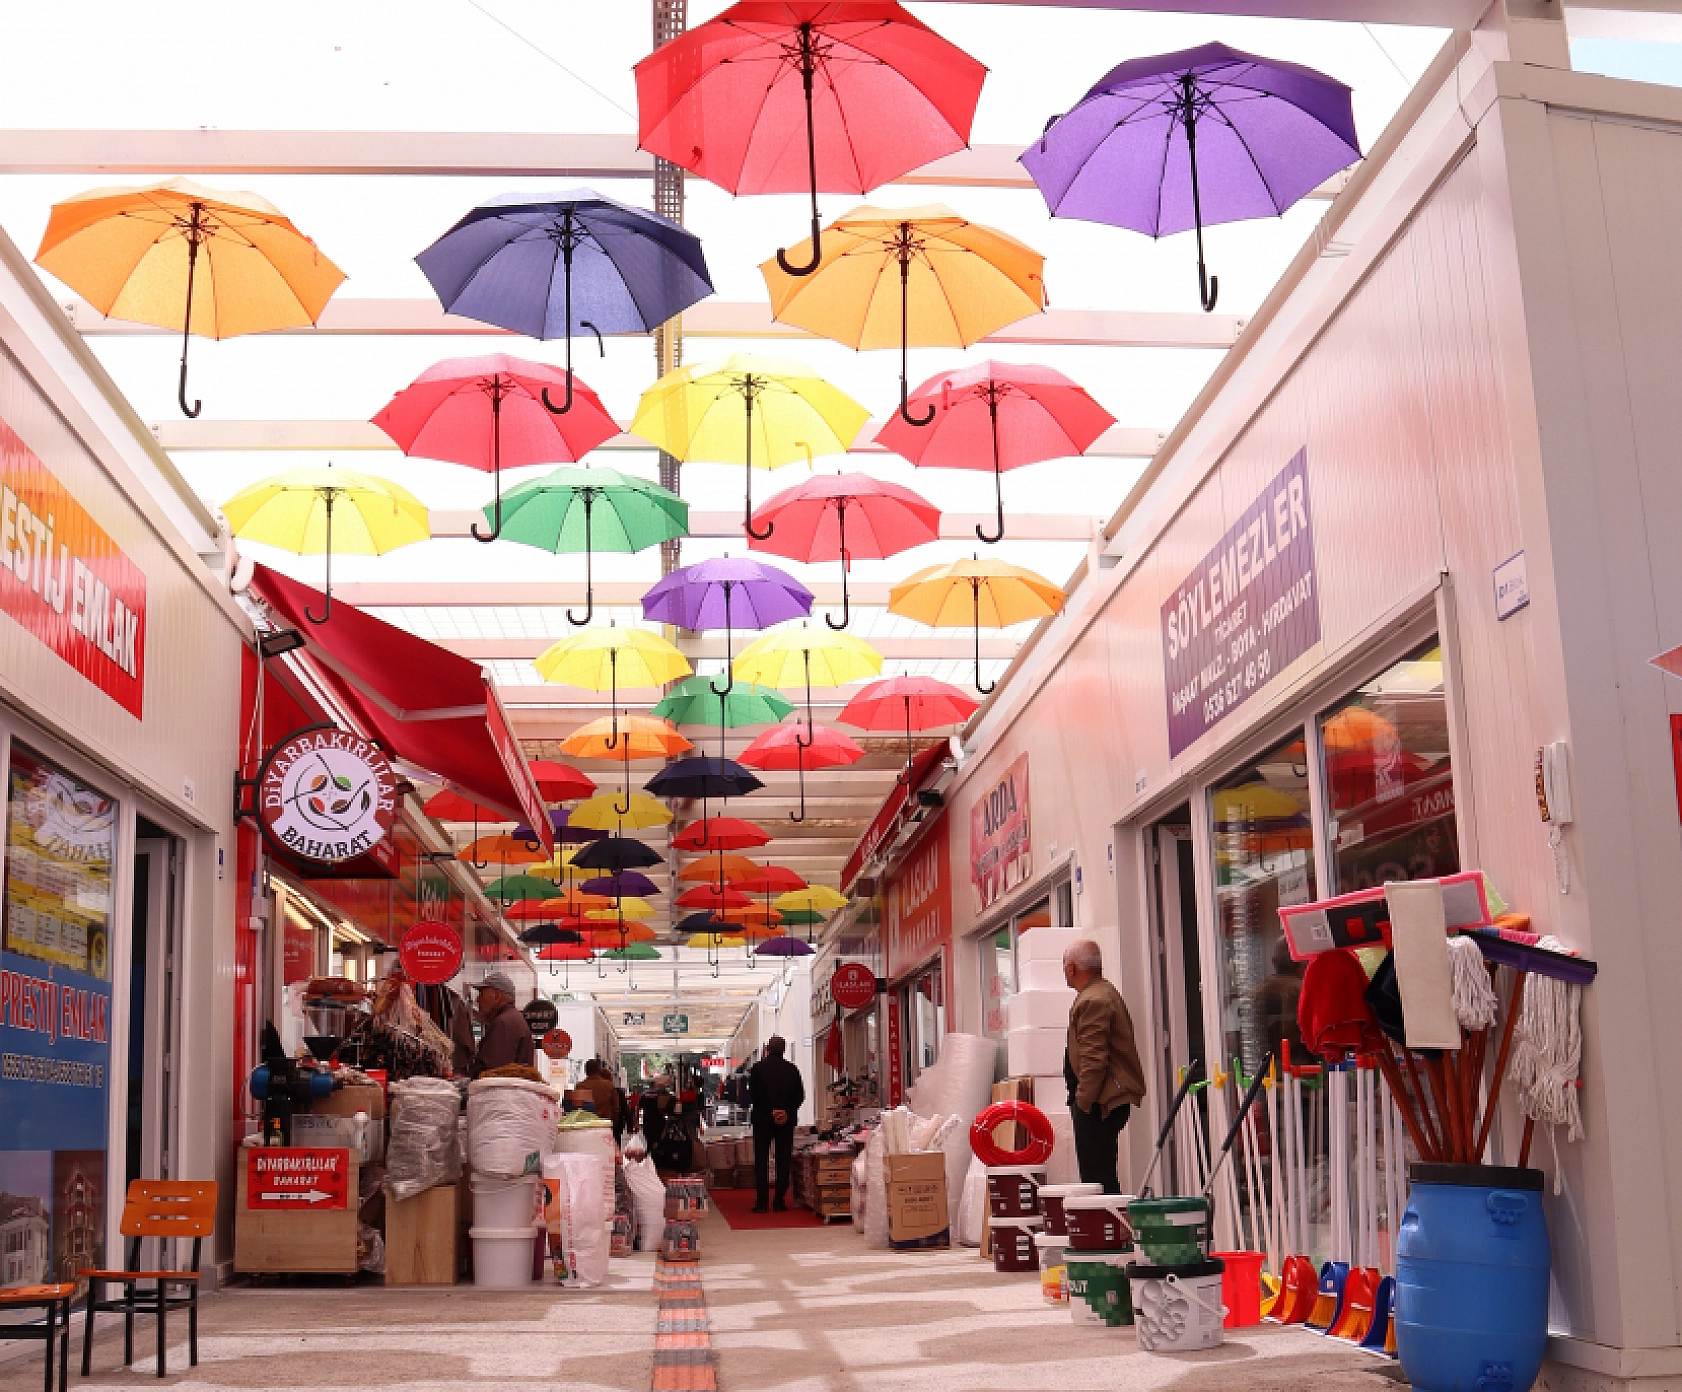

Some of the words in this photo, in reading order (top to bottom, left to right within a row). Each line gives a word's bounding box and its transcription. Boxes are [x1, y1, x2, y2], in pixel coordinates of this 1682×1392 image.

[1168, 474, 1308, 661] SÖYLEMEZLER
[71, 556, 138, 680] EMLAK
[281, 825, 372, 858] BAHARAT
[983, 773, 1018, 838] ARDA
[0, 966, 58, 1046] PRESTİJ
[61, 985, 109, 1044] EMLAK
